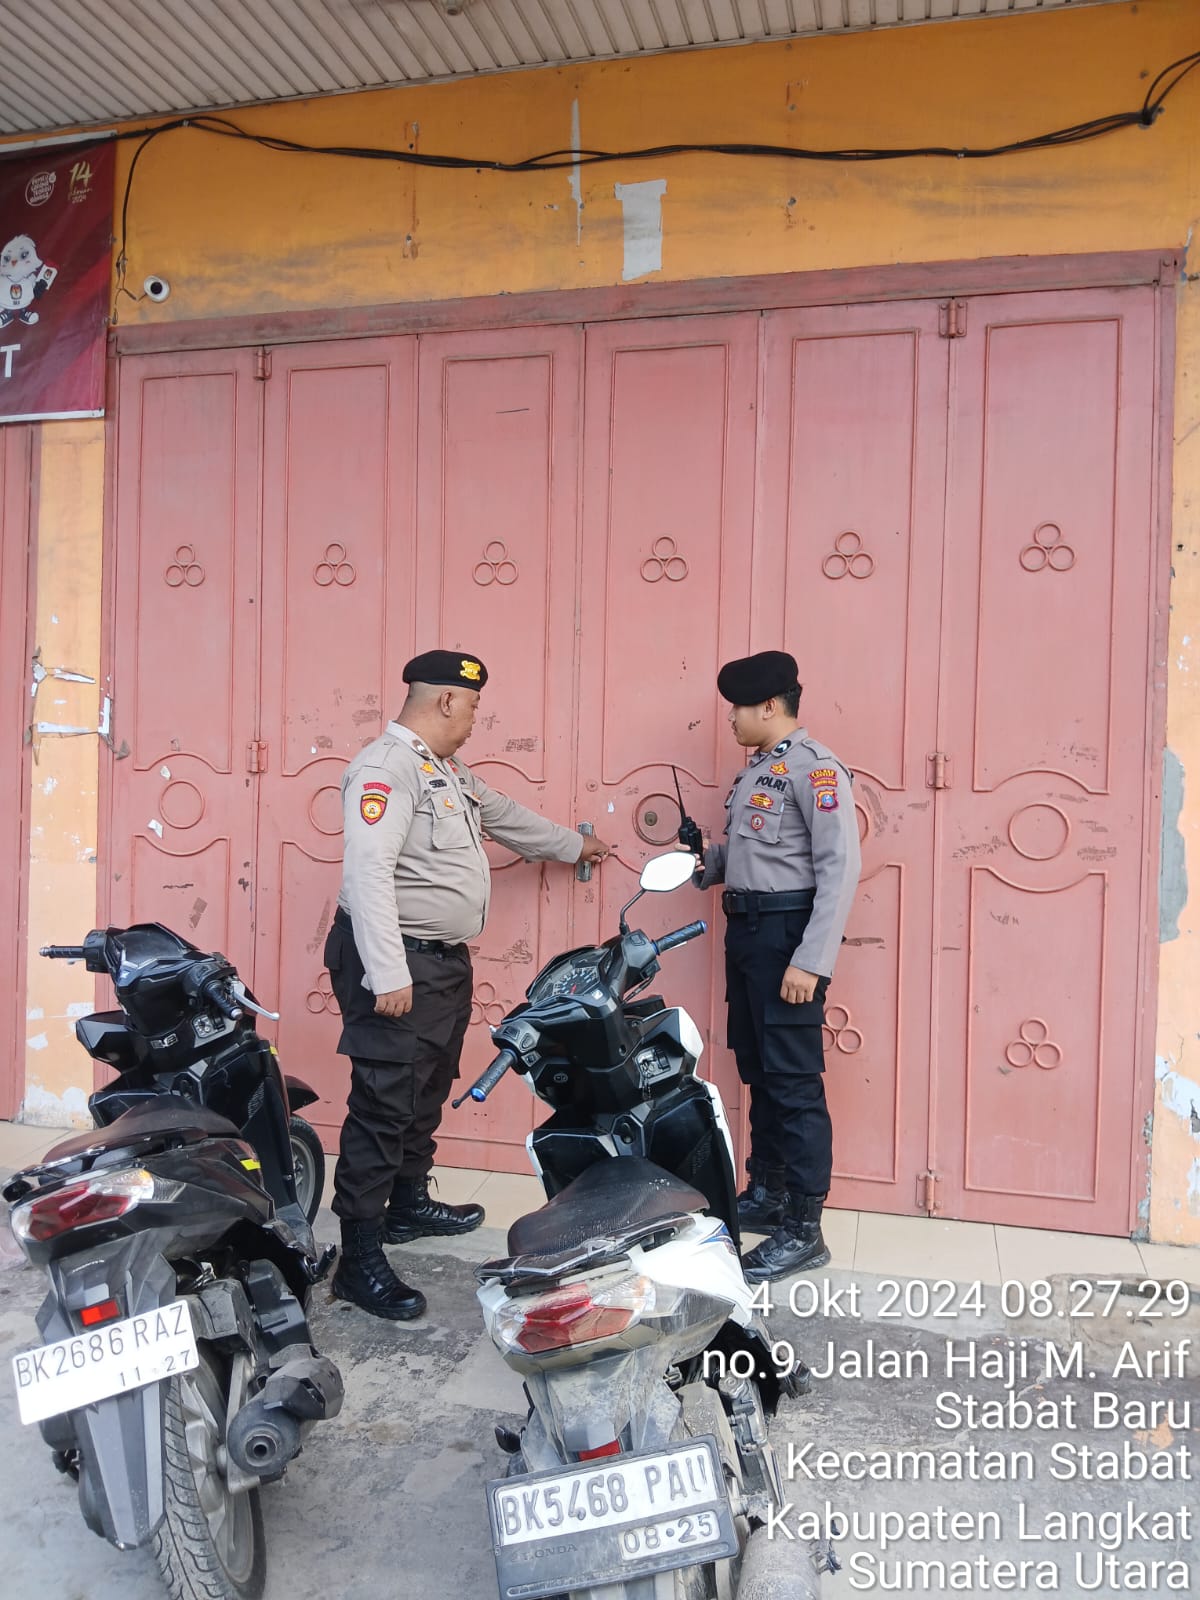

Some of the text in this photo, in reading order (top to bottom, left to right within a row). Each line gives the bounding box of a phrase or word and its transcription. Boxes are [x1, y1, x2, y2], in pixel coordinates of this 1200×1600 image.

[69, 160, 94, 190] 14
[0, 344, 21, 378] T
[755, 775, 788, 792] POLRI
[133, 1304, 188, 1349] RAZ
